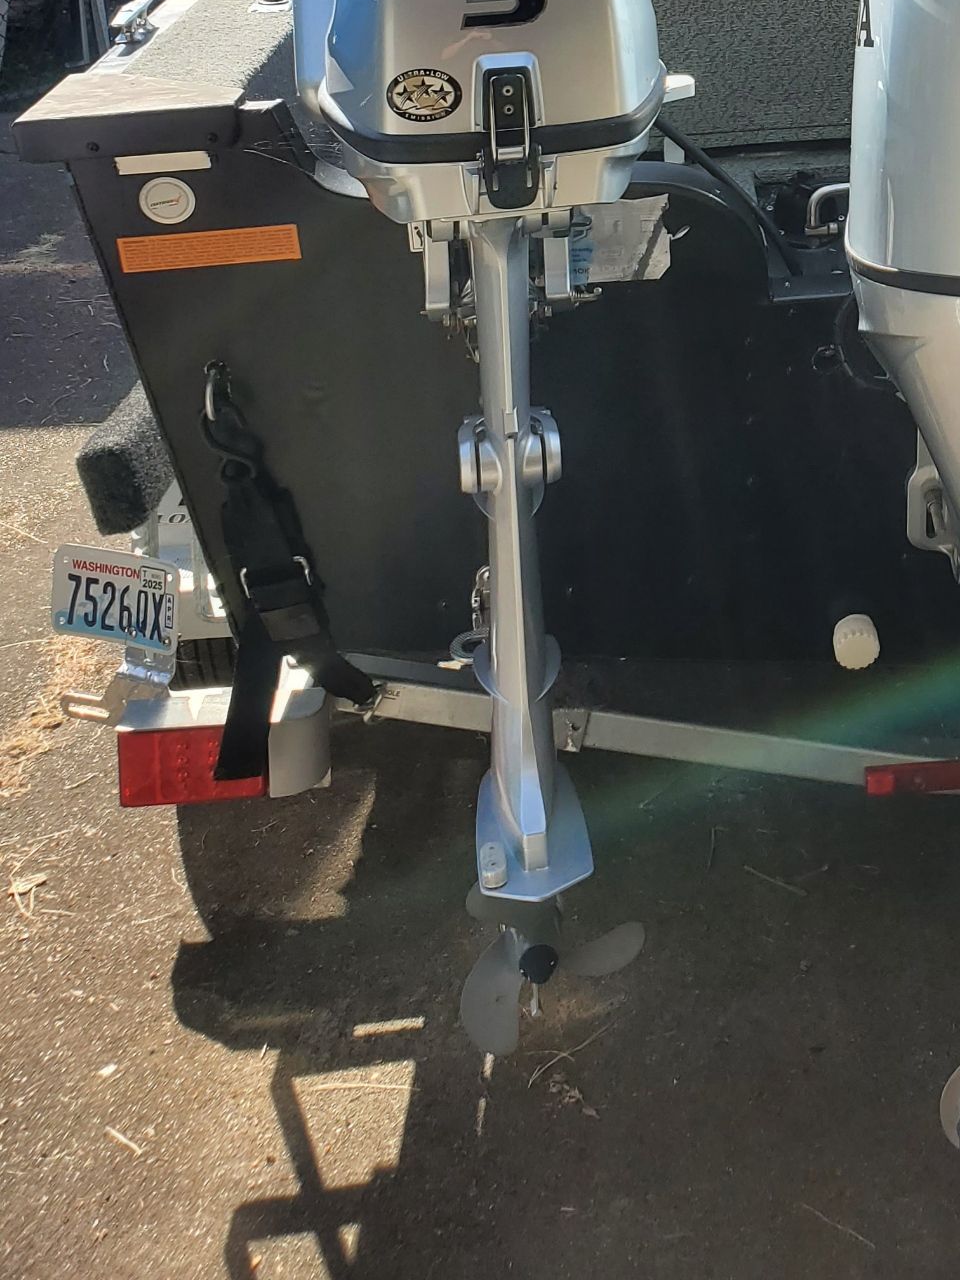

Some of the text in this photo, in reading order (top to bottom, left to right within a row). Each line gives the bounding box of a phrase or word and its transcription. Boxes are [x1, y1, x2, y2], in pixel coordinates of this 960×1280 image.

[72, 559, 140, 579] WASHINGTON
[142, 578, 163, 591] 2025
[66, 573, 164, 644] 7526QX
